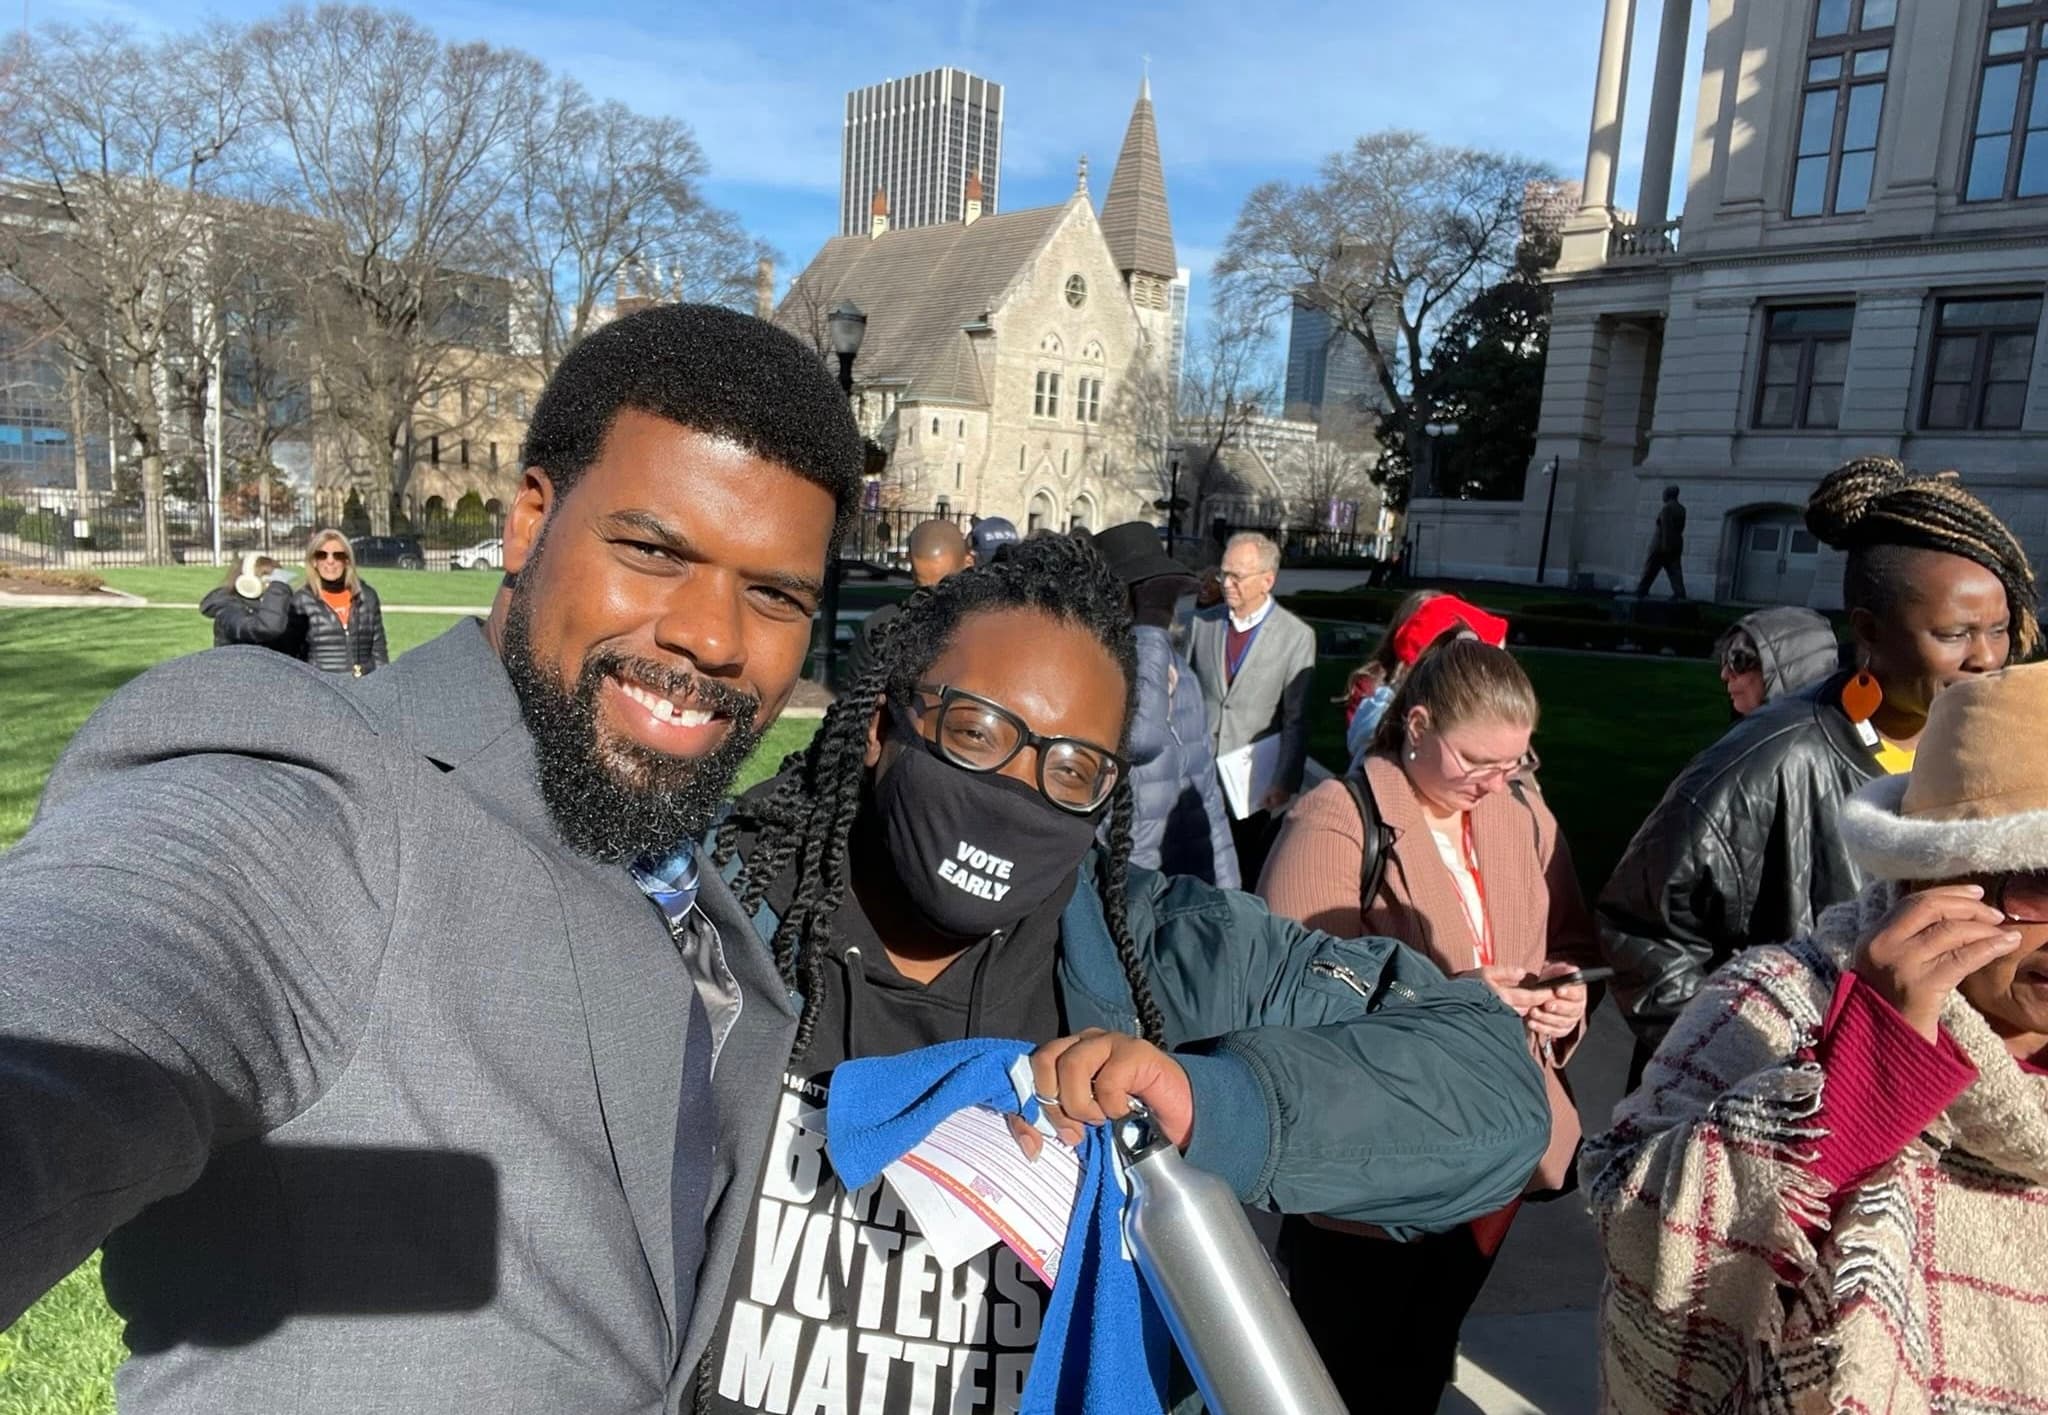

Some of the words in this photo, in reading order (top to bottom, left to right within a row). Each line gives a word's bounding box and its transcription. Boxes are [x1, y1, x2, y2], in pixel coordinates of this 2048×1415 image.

[938, 858, 1011, 901] EARLY
[957, 840, 1014, 879] VOTE
[751, 1199, 1041, 1348] VOTERS
